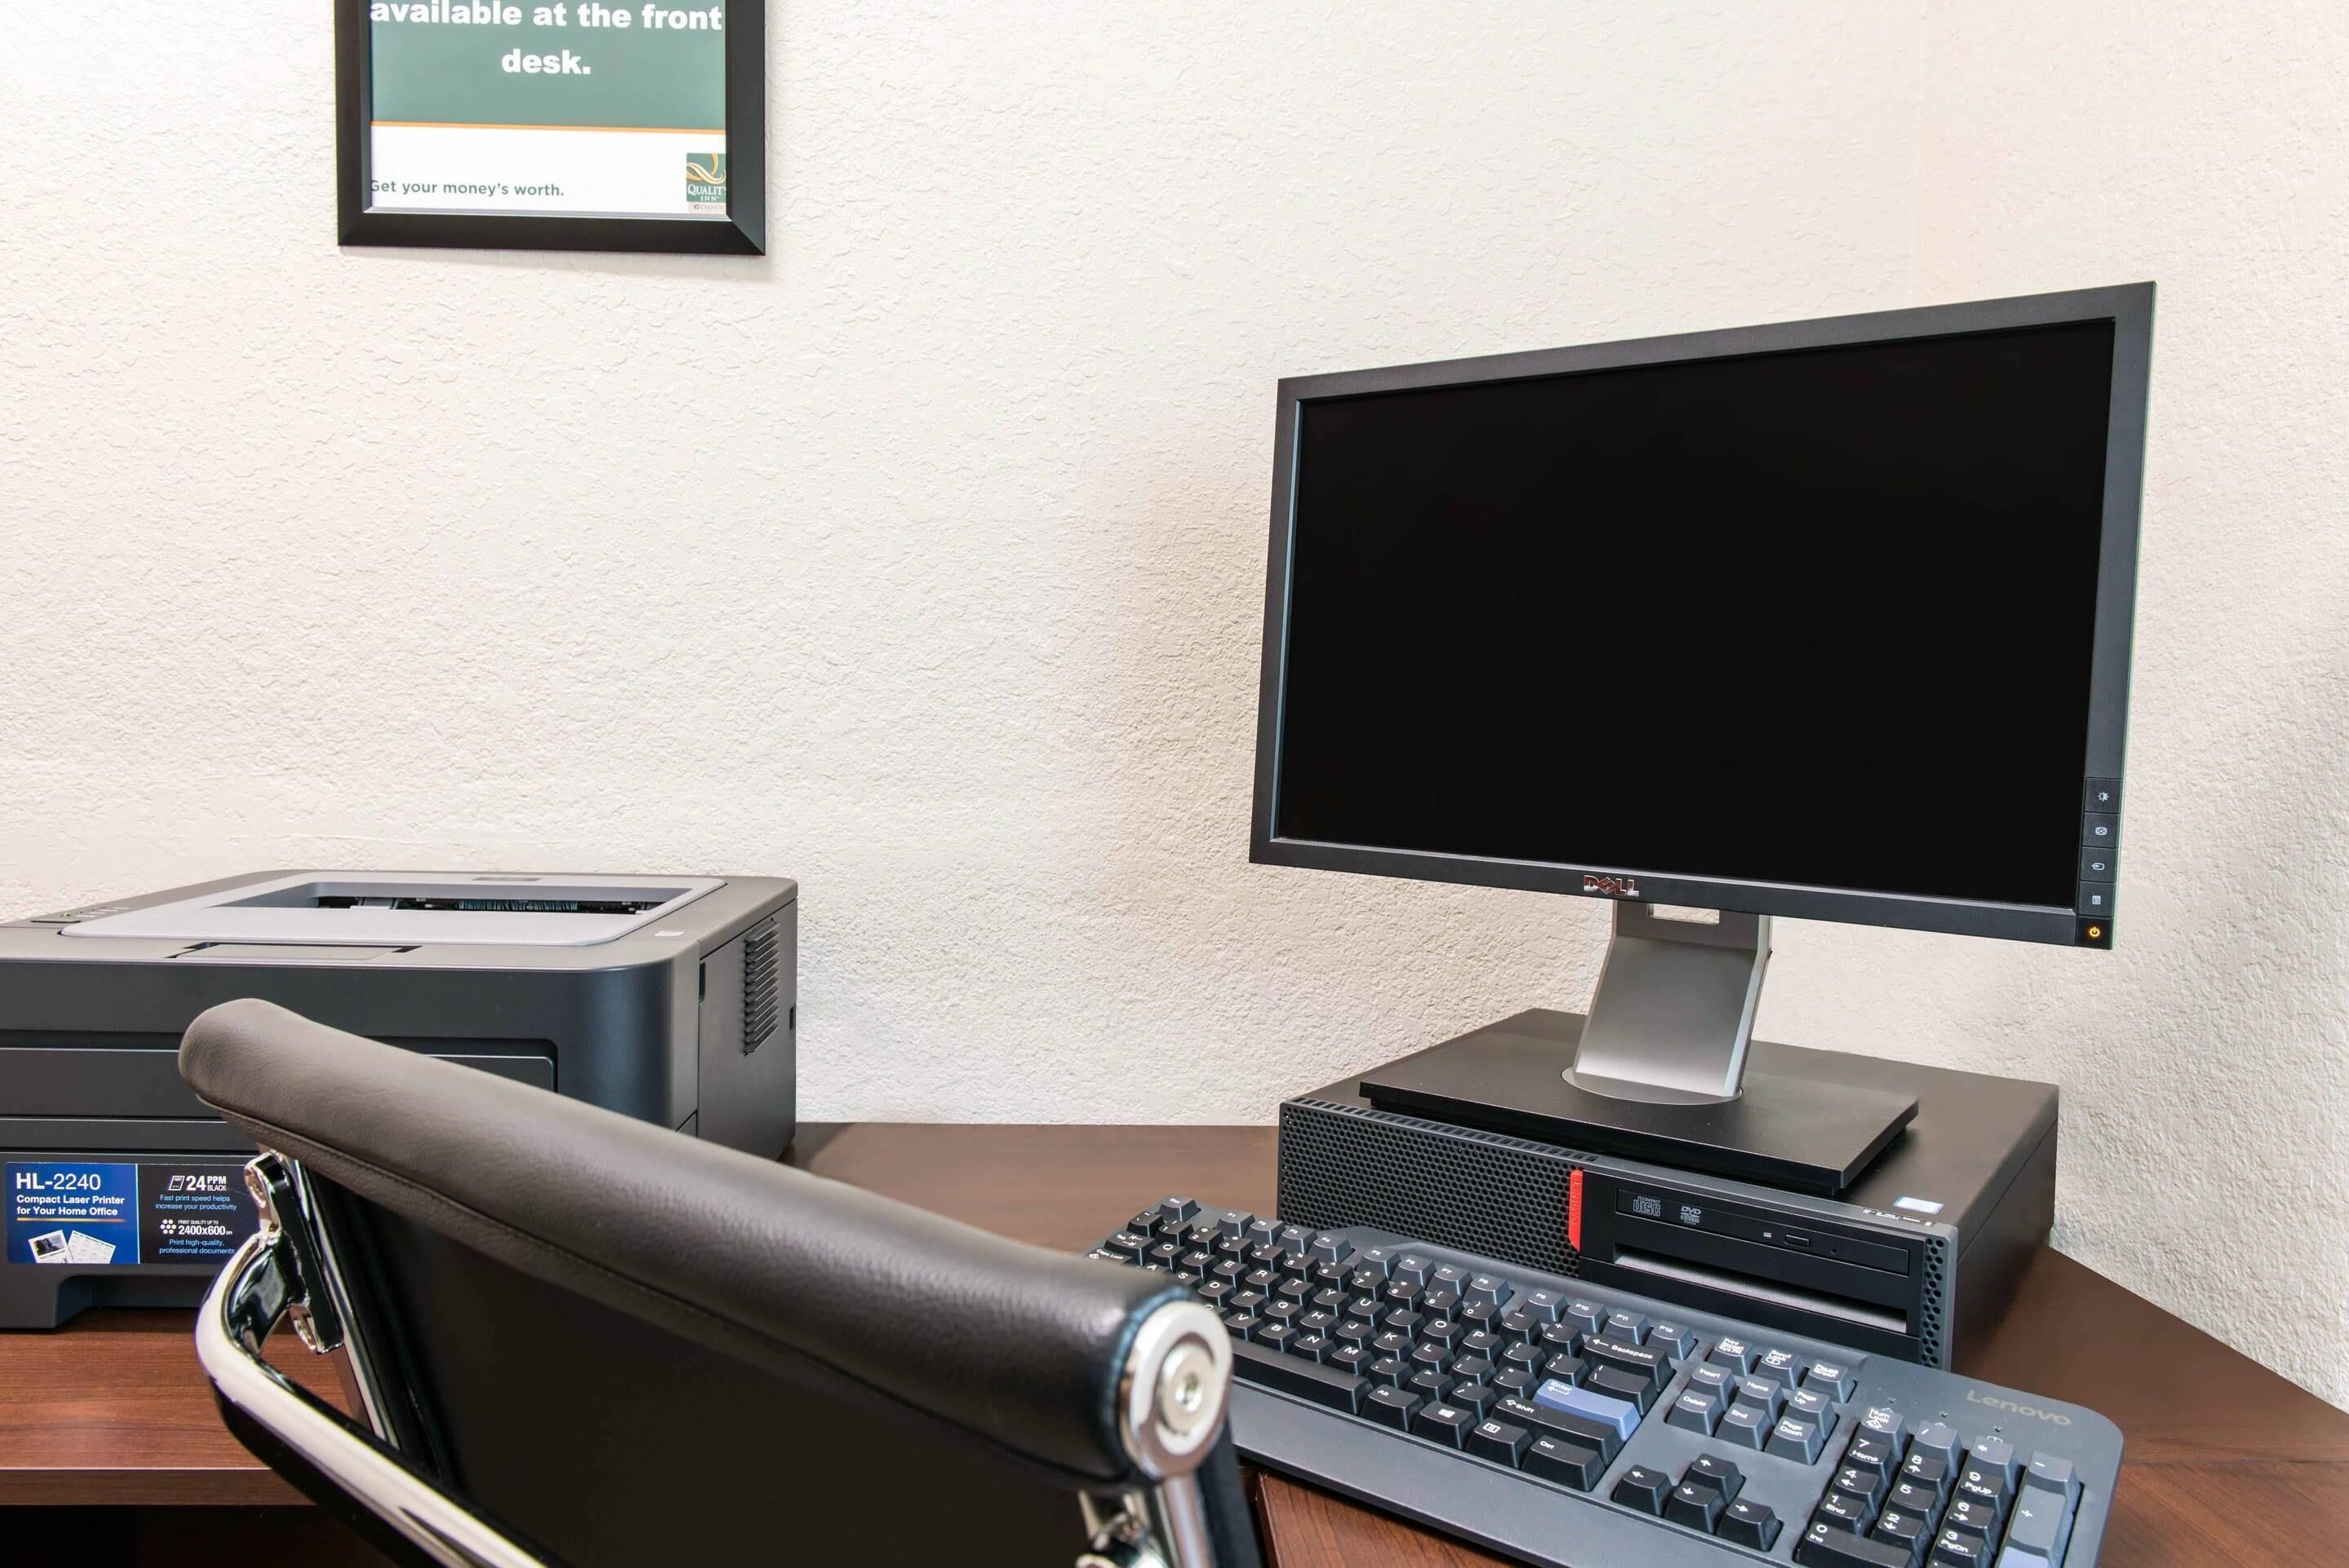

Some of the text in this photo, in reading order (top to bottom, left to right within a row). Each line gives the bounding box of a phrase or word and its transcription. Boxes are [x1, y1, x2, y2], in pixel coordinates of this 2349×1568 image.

[369, 0, 723, 31] available at the front
[501, 48, 591, 76] desk.
[371, 179, 565, 197] Get your money's worth.
[1583, 874, 1639, 897] DELL
[16, 1173, 101, 1190] HL-2240
[186, 1175, 206, 1191] 24
[207, 1175, 227, 1185] PPM
[16, 1195, 125, 1205] Compact Laser Printer
[175, 1195, 191, 1203] print
[16, 1206, 118, 1216] for Your Home Office
[199, 1204, 237, 1212] productivity
[1633, 1195, 1661, 1217] disc
[1680, 1205, 1701, 1215] DVD
[179, 1226, 226, 1235] 2400x600
[185, 1239, 225, 1248] high-quality,
[1193, 1252, 1208, 1260] W
[1256, 1270, 1268, 1278] R
[1360, 1298, 1371, 1306] U
[1575, 1303, 1590, 1311] F10
[1311, 1311, 1325, 1320] H
[1658, 1325, 1674, 1333] F12
[1307, 1335, 1320, 1344] N
[1384, 1332, 1398, 1341] K
[1343, 1346, 1360, 1355] M
[1423, 1344, 1432, 1352] L
[1611, 1345, 1653, 1359] Backspace
[1699, 1368, 1721, 1378] Insert
[1551, 1381, 1573, 1391] Enter
[1747, 1380, 1769, 1392] Home
[1794, 1396, 1806, 1405] Up
[1797, 1390, 1817, 1402] Page
[1683, 1396, 1707, 1407] Delete
[1515, 1403, 1535, 1413] Shift
[1966, 1389, 2073, 1425] Lenovo
[1731, 1409, 1749, 1420] End
[1782, 1420, 1803, 1431] Page
[1780, 1426, 1803, 1437] Down
[1540, 1441, 1555, 1450] Ctrl
[1859, 1438, 1870, 1448] 7
[1851, 1450, 1879, 1462] Home
[1911, 1455, 1922, 1465] 8
[1845, 1469, 1857, 1479] 4
[1968, 1471, 1981, 1482] 9
[1900, 1484, 1913, 1494] 5
[1965, 1481, 1993, 1495] PgUp
[1825, 1504, 1847, 1515] End
[1957, 1502, 1971, 1512] 6
[1887, 1513, 1900, 1523] 2
[1809, 1533, 1825, 1543] Ins
[1945, 1530, 1958, 1541] 3
[1940, 1539, 1969, 1553] PgDn
